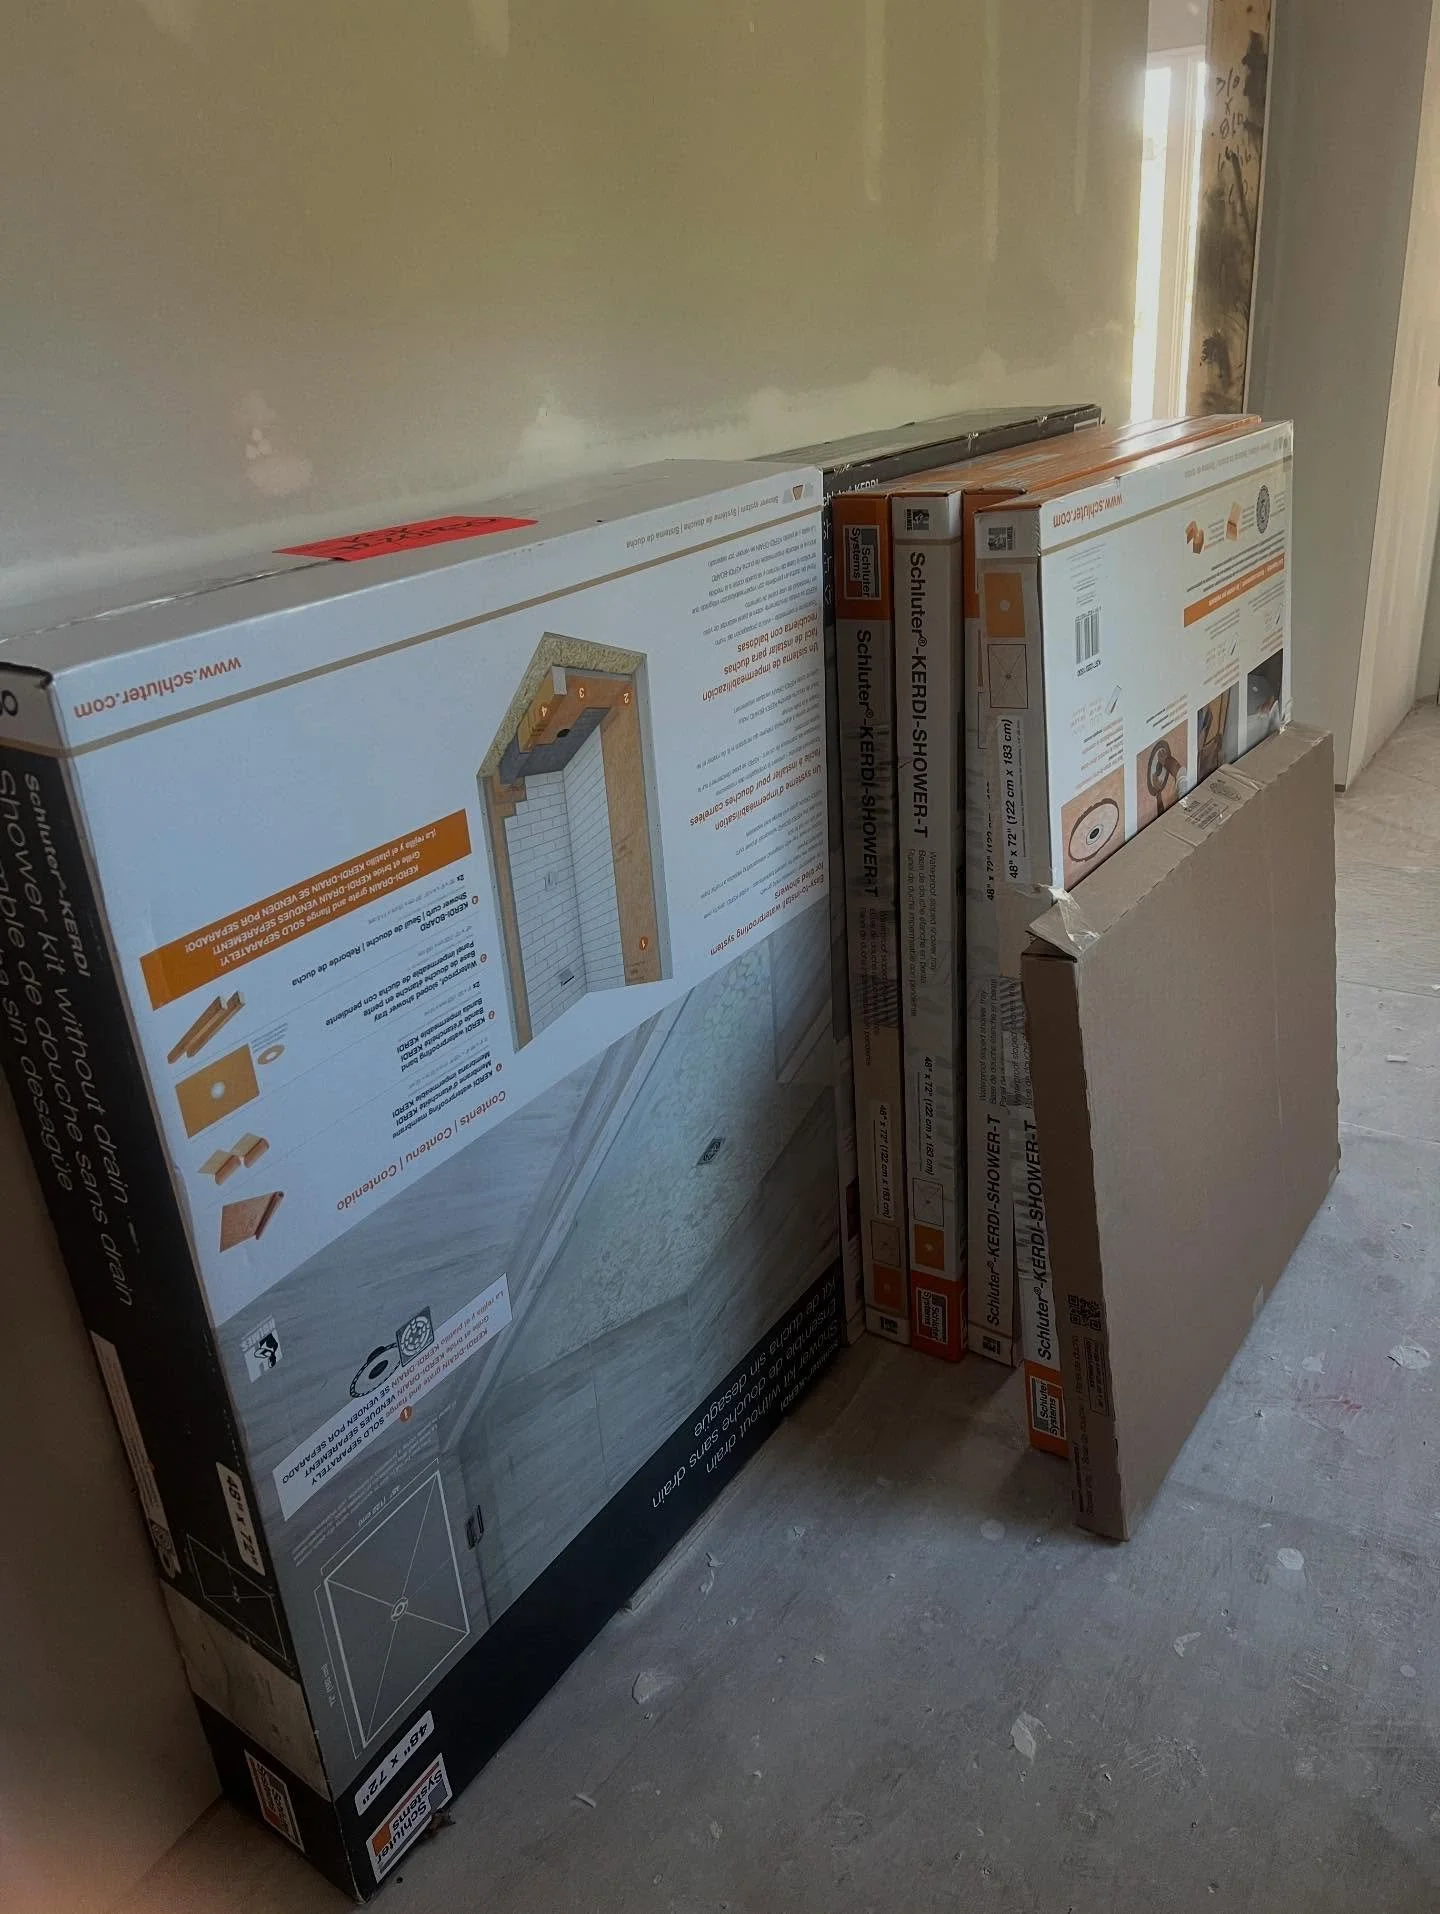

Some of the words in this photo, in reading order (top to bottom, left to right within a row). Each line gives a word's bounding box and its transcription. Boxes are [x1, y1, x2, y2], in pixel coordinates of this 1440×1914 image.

[1052, 491, 1122, 528] www.schluter.com
[849, 527, 861, 578] Systems
[860, 548, 871, 597] Schluter
[737, 631, 768, 652] baldosas
[770, 626, 782, 638] con
[794, 633, 802, 644] de
[751, 646, 767, 663] para
[768, 637, 793, 655] instalar
[723, 656, 749, 675] duchas
[772, 657, 781, 669] de
[73, 656, 241, 718] www.schluter.com
[702, 662, 770, 701] impermeabilización
[908, 551, 929, 838] Schluter®-KERDI-SHOWER-T
[1000, 718, 1012, 741] cm)
[855, 629, 878, 897] Schluter®-KERDI-SHOWER-T
[1002, 743, 1012, 765] 183
[754, 772, 770, 789] pour
[1005, 768, 1013, 776] x
[725, 783, 754, 806] douches
[1006, 779, 1014, 797] cm
[689, 801, 723, 826] carrelées
[1005, 800, 1017, 825] (122
[0, 765, 49, 922] Shower
[1006, 827, 1016, 847] 72"
[392, 859, 400, 870] et
[400, 849, 420, 864] Grille
[1010, 848, 1017, 857] x
[311, 862, 364, 894] KERDI-DRAIN
[368, 863, 418, 894] KERDI-DRAIN
[371, 863, 392, 878] bride
[1008, 859, 1018, 879] 48"
[297, 887, 310, 900] SE
[318, 872, 371, 905] KERDI-DRAIN
[347, 885, 367, 903] grate
[441, 890, 467, 908] Shower
[774, 875, 800, 899] showers
[261, 893, 297, 917] VENDEN
[276, 898, 318, 925] VENDUES
[331, 897, 346, 912] and
[419, 899, 468, 932] KERDI-BOARD
[425, 903, 441, 918] curb
[239, 910, 260, 927] POR
[280, 918, 305, 937] SOLD
[393, 923, 403, 933] de
[403, 914, 421, 930] Seuil
[735, 902, 780, 938] waterproofing
[183, 920, 239, 953] SEPARADO!
[219, 930, 280, 967] SEPARATELY!
[365, 929, 393, 948] douche
[455, 939, 474, 956] Panel
[710, 933, 734, 956] system
[36, 930, 69, 977] kit
[328, 945, 361, 967] Reborde
[411, 949, 455, 978] impermeable
[449, 958, 458, 968] de
[459, 949, 476, 963] Base
[291, 968, 316, 986] ducha
[316, 962, 327, 973] de
[402, 974, 411, 984] de
[423, 964, 449, 983] douche
[362, 993, 377, 1006] con
[378, 980, 401, 997] ducha
[384, 994, 394, 1005] en
[414, 980, 438, 1000] sloped
[324, 998, 362, 1027] pendiente
[362, 998, 383, 1017] pente
[373, 1009, 388, 1022] tray
[388, 994, 414, 1014] shower
[462, 996, 482, 1013] Banda
[463, 1005, 483, 1022] Bande
[419, 1009, 461, 1038] impermeable
[464, 1015, 485, 1033] KERDI
[52, 983, 109, 1118] without
[396, 1035, 419, 1054] KERDI
[399, 1043, 423, 1062] KERDI
[418, 1028, 463, 1060] waterproofing
[400, 1056, 418, 1073] band
[457, 1049, 490, 1074] Membrana
[458, 1059, 491, 1083] Membrane
[924, 1055, 933, 1072] 48"
[414, 1071, 456, 1102] impermeable
[472, 1068, 492, 1087] KERDI
[924, 1080, 933, 1097] 72"
[1, 997, 28, 1046] sin
[18, 1053, 74, 1193] desagüe
[427, 1082, 472, 1115] waterproofing
[459, 1087, 506, 1127] Contents
[923, 1098, 934, 1116] (122
[391, 1098, 414, 1119] KERDI
[395, 1106, 418, 1126] KERDI
[17, 959, 44, 1008] de
[33, 1014, 85, 1145] douche
[74, 1149, 109, 1226] sans
[98, 1230, 135, 1308] drain
[391, 1111, 427, 1138] membrane
[925, 1118, 932, 1133] cm
[404, 1124, 452, 1164] Contenu
[925, 1141, 934, 1156] 183
[92, 1121, 131, 1206] drain
[924, 1158, 935, 1176] cm)
[335, 1162, 397, 1212] Contenido
[1022, 1119, 1051, 1360] Schluter®-KERDI-SHOWER-T
[820, 1273, 835, 1303] Kit
[805, 1291, 819, 1316] de
[921, 1291, 931, 1325] Systems
[768, 1310, 802, 1356] ducha
[785, 1298, 836, 1363] Ensemble
[931, 1305, 940, 1340] Schluter
[799, 1317, 836, 1369] Shower
[390, 1343, 440, 1391] KERDI-DRAIN
[396, 1351, 445, 1398] KERDI-DRAIN
[749, 1350, 766, 1378] sin
[768, 1357, 782, 1381] de
[783, 1363, 796, 1390] kit
[379, 1386, 390, 1401] SE
[694, 1371, 747, 1439] desagüe
[722, 1375, 766, 1433] douche
[1038, 1380, 1048, 1418] Schluter
[346, 1395, 379, 1429] VENDEN
[359, 1393, 395, 1430] VENDUES
[739, 1381, 780, 1441] without
[1048, 1397, 1058, 1436] Systems
[328, 1424, 346, 1444] POR
[362, 1415, 384, 1440] SOLD
[310, 1435, 362, 1485] SEPARATELY
[688, 1427, 718, 1470] sans
[705, 1431, 736, 1475] drain
[281, 1440, 327, 1485] SEPARADO
[224, 1472, 244, 1513] 48"
[652, 1464, 685, 1510] drain
[234, 1511, 245, 1526] x
[239, 1528, 259, 1566] 72"
[402, 1719, 428, 1758] 48"
[389, 1753, 399, 1770] x
[361, 1767, 387, 1806] 72"
[391, 1768, 442, 1832] Systems
[375, 1798, 427, 1865] Schluter
